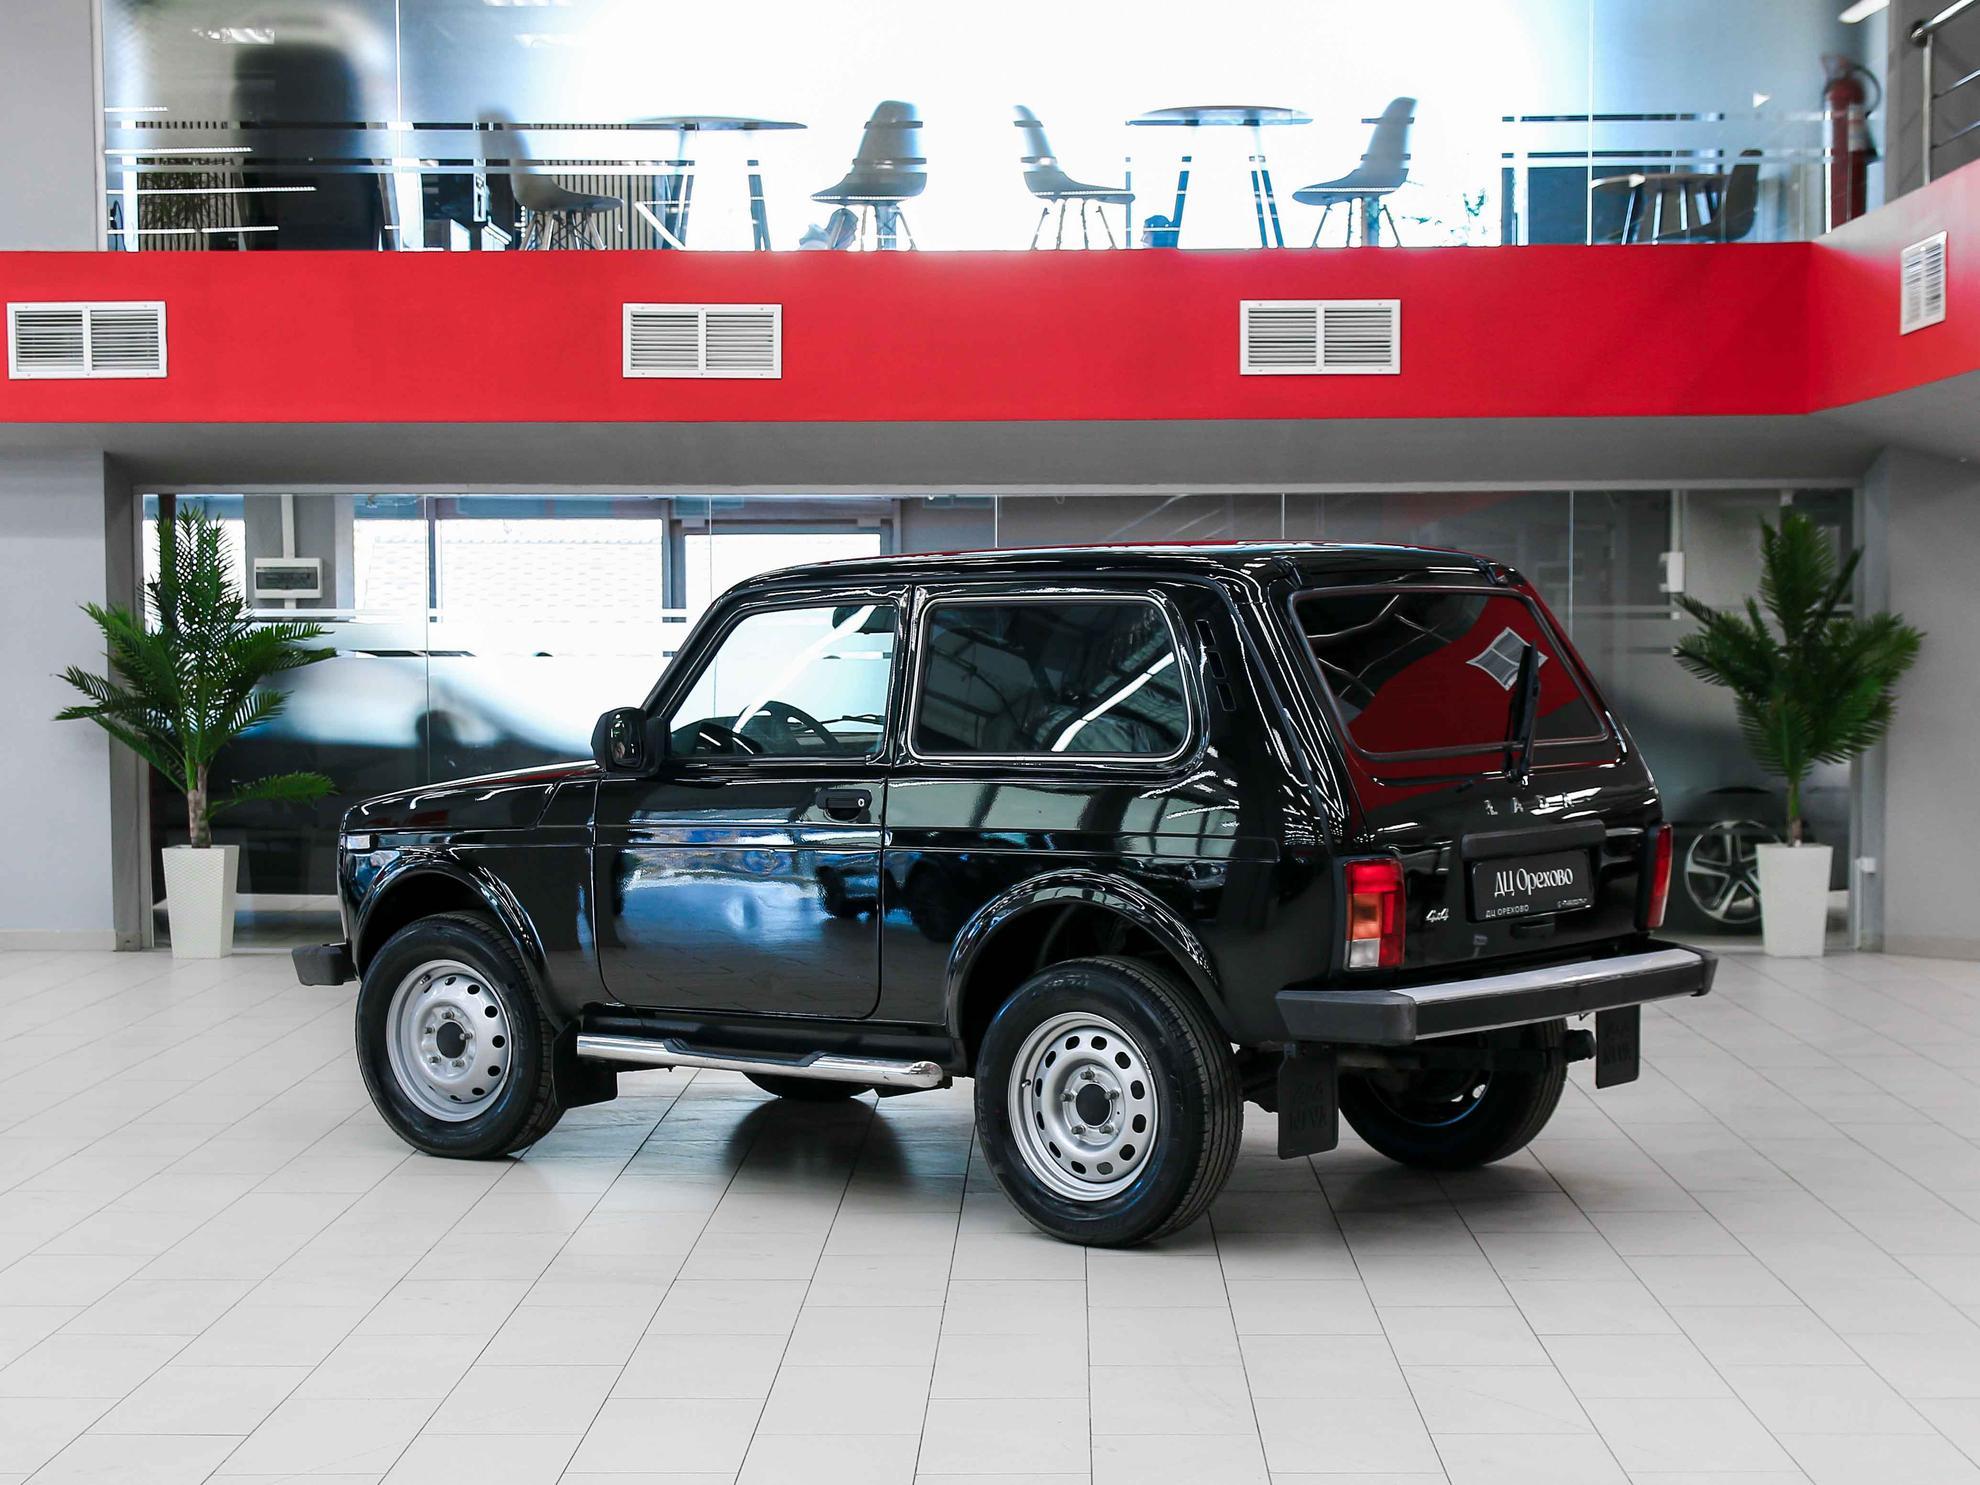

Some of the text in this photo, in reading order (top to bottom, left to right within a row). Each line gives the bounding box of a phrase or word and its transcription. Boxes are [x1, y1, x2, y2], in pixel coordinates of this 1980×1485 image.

[1494, 868, 1574, 898] ДЦ Орехово
[1497, 905, 1530, 916] ОРЕХОВО
